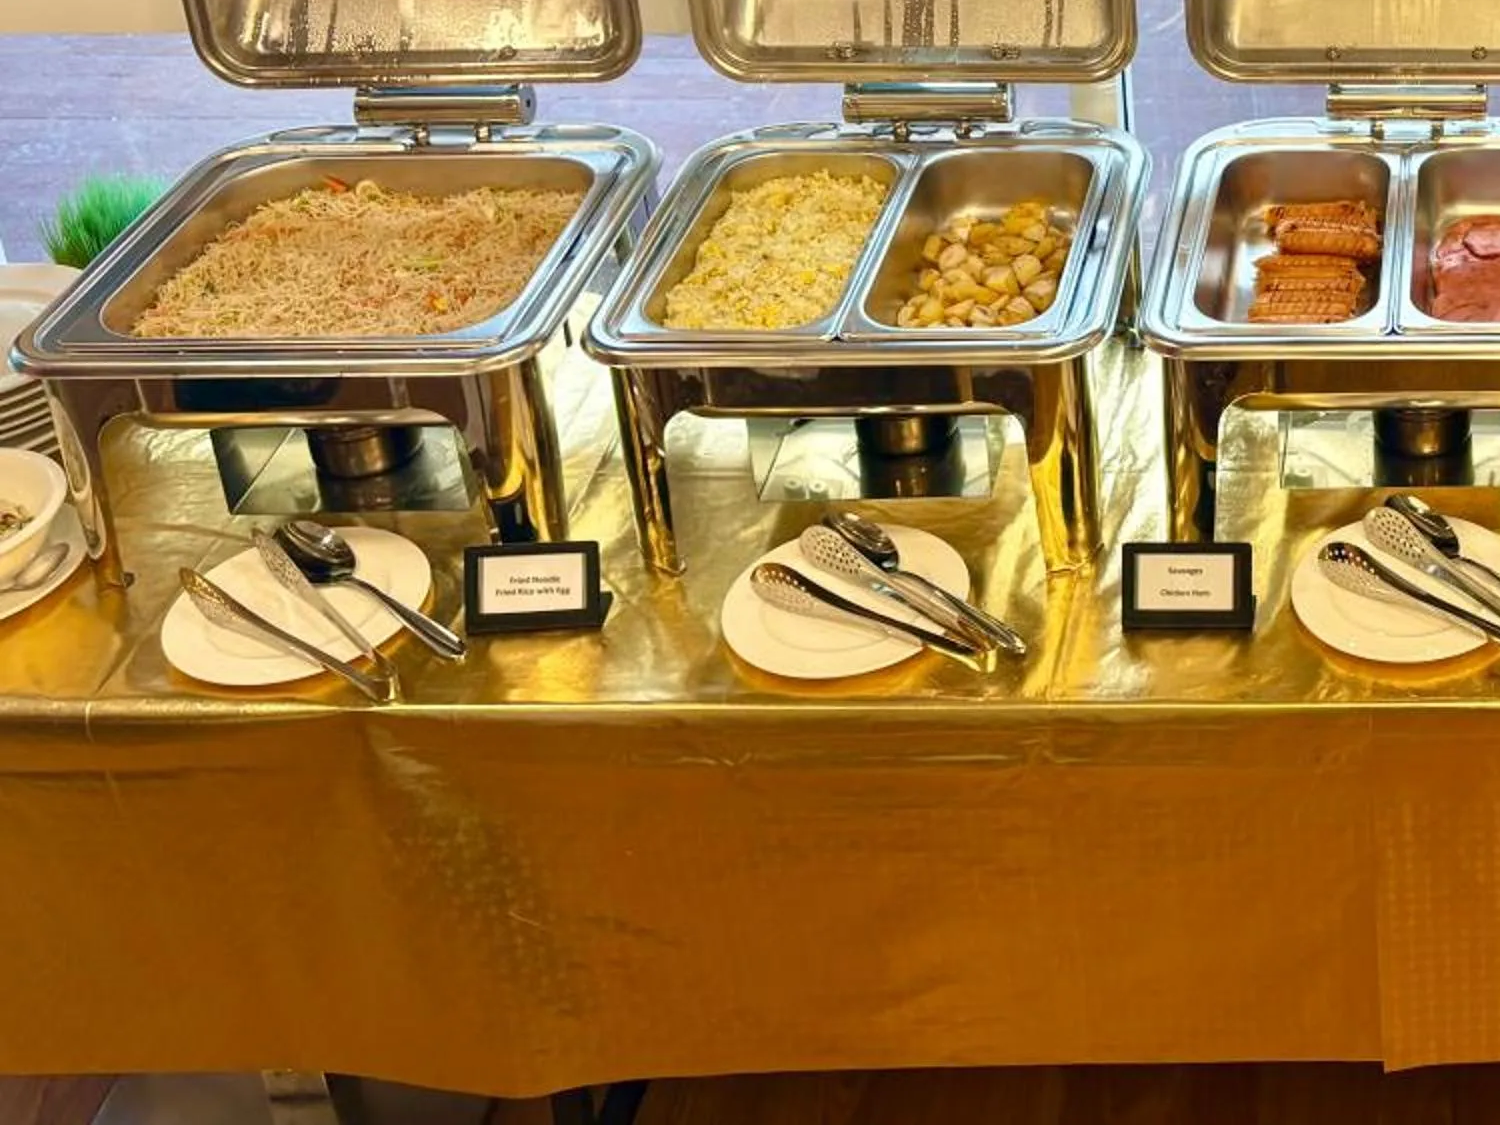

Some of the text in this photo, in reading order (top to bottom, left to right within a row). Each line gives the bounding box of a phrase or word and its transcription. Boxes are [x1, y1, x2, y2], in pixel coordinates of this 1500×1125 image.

[1167, 566, 1204, 576] Sausages
[509, 576, 530, 584] Fried
[495, 586, 571, 597] Fried Rice with Egg
